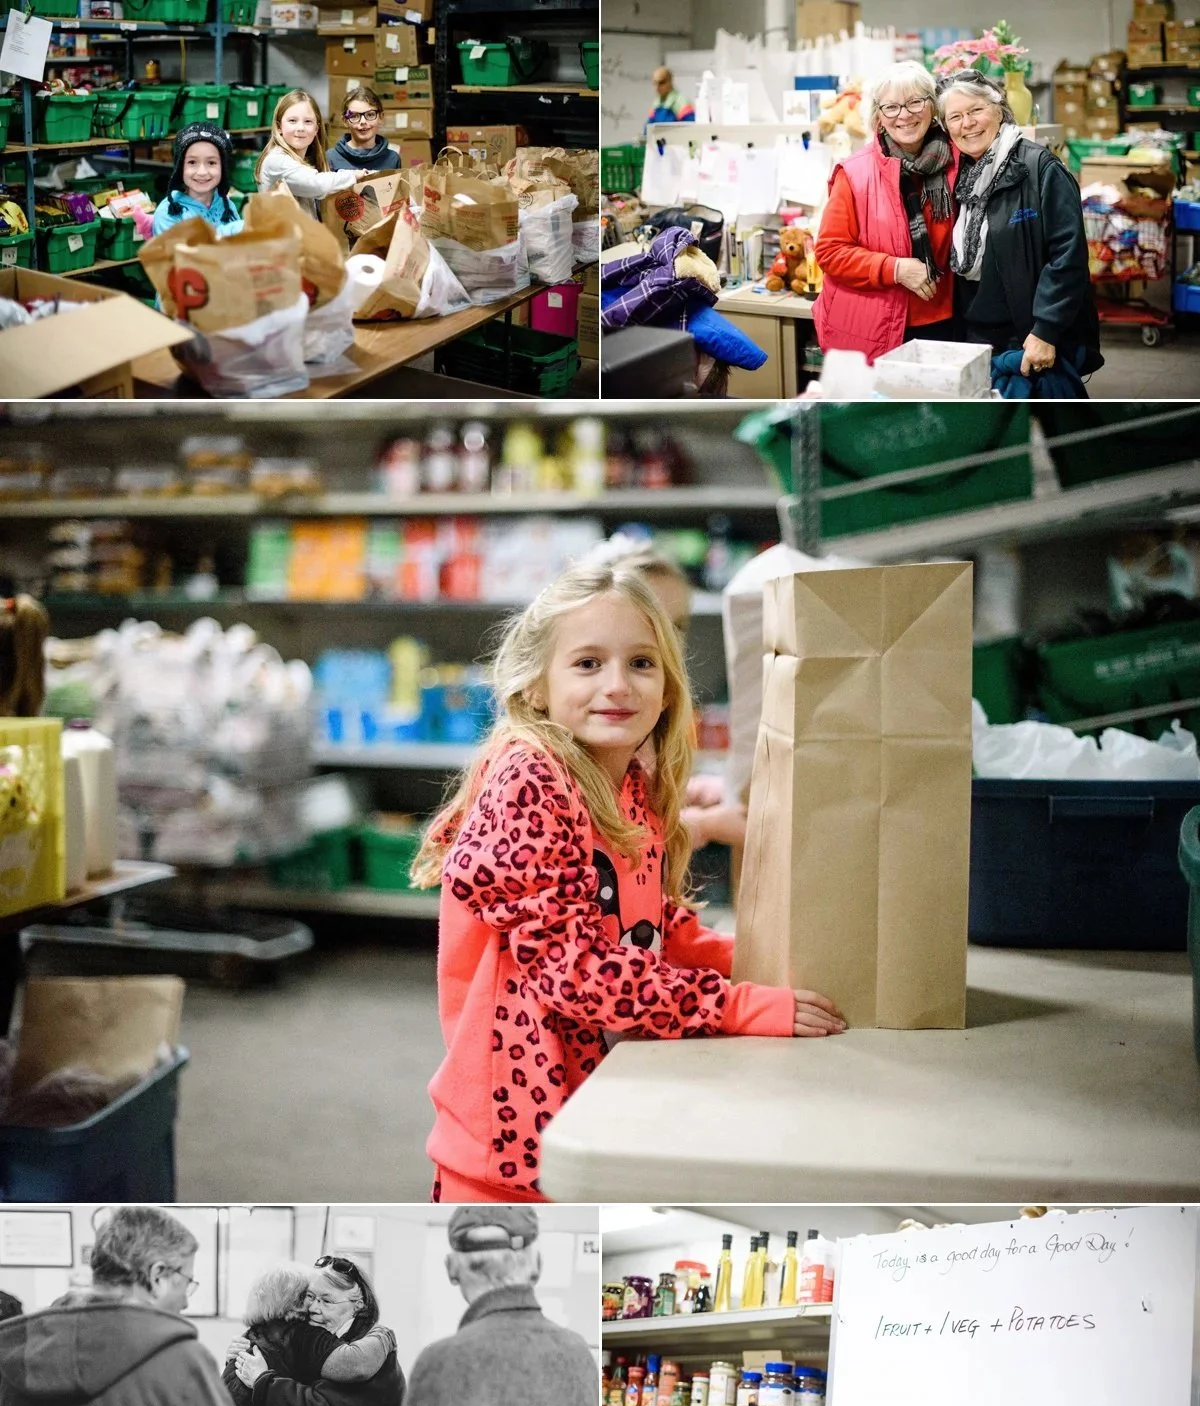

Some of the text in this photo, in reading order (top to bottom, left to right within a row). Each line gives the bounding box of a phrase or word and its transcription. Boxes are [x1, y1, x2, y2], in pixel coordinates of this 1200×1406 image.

[873, 1249, 911, 1282] Today
[939, 1246, 978, 1275] good
[980, 1243, 1001, 1272] day
[1004, 1238, 1027, 1256] for
[1045, 1233, 1082, 1261] Good
[1007, 1305, 1096, 1332] POTATOES
